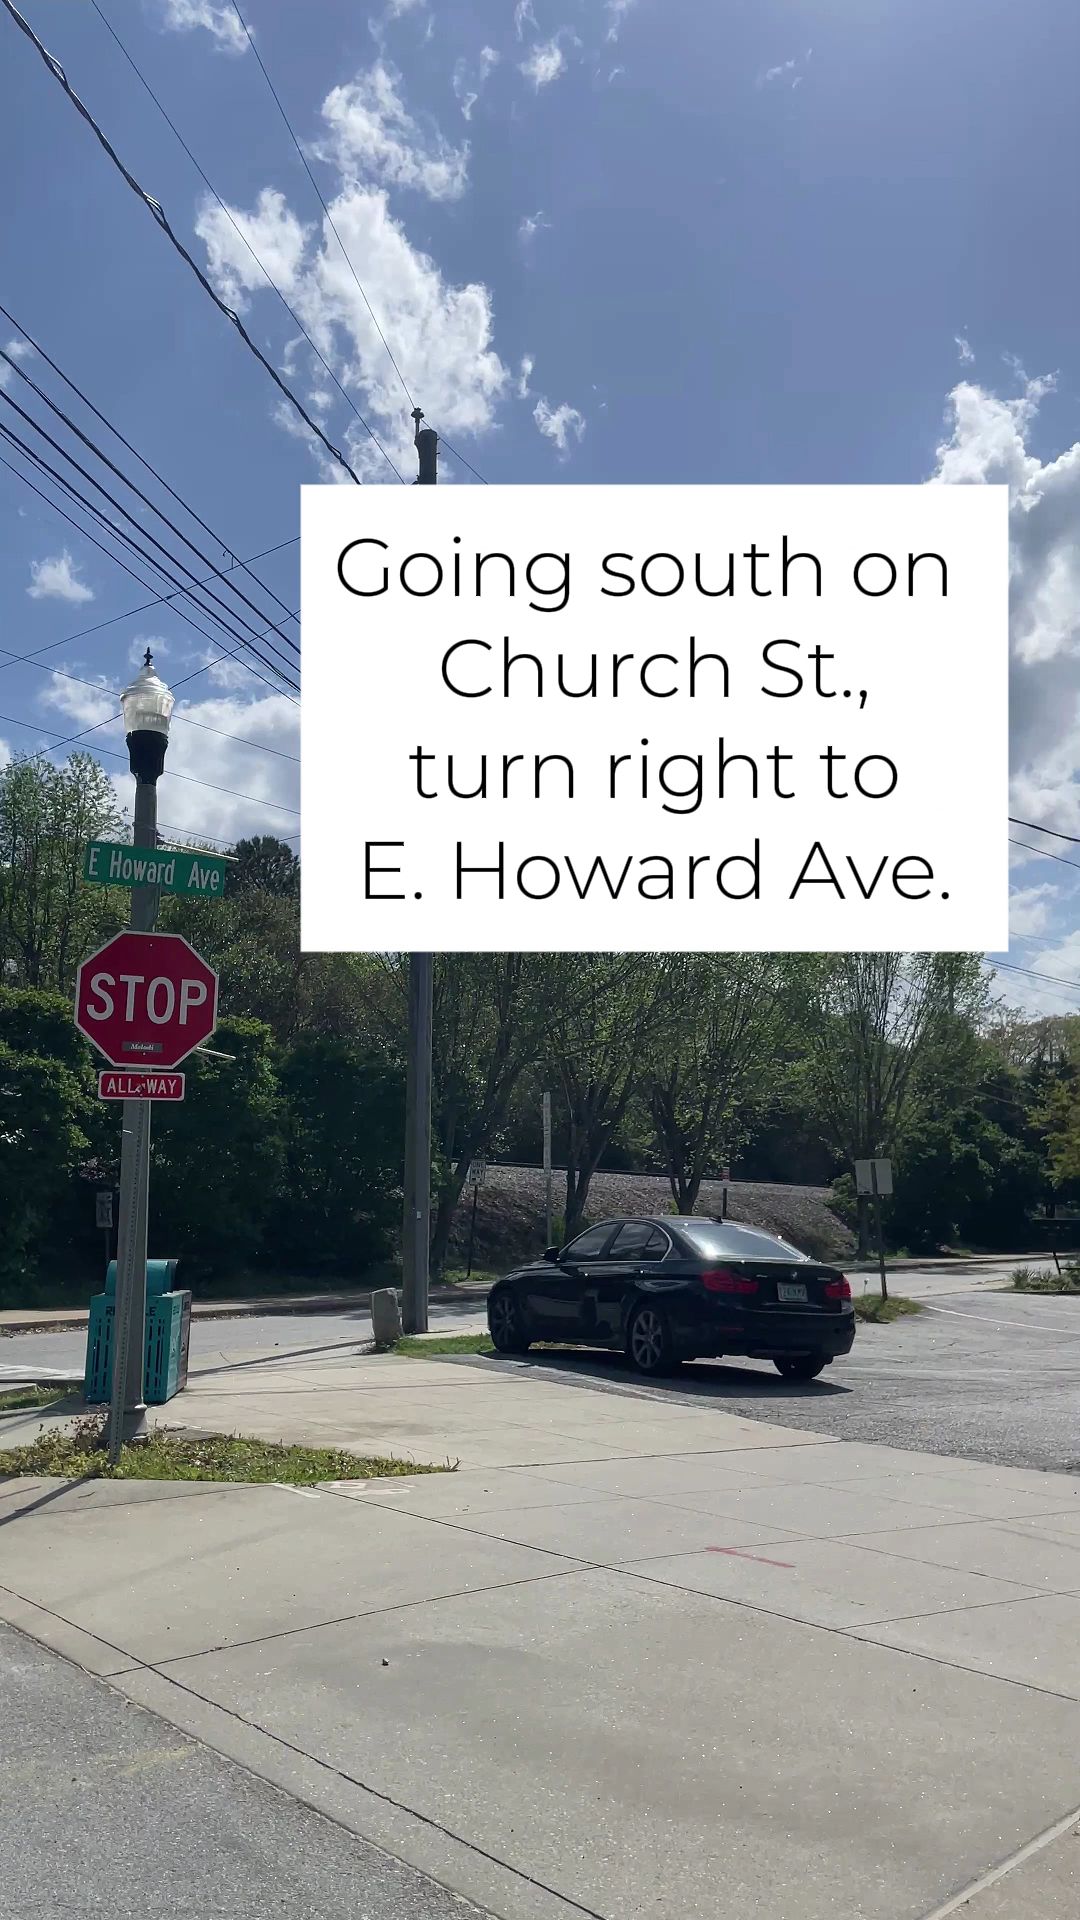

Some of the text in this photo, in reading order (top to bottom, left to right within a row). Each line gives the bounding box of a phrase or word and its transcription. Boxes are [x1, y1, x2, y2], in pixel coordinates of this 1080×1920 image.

[88, 848, 221, 891] E Howard Ave
[86, 972, 208, 1025] STOP
[107, 1077, 177, 1095] ALL WAY
